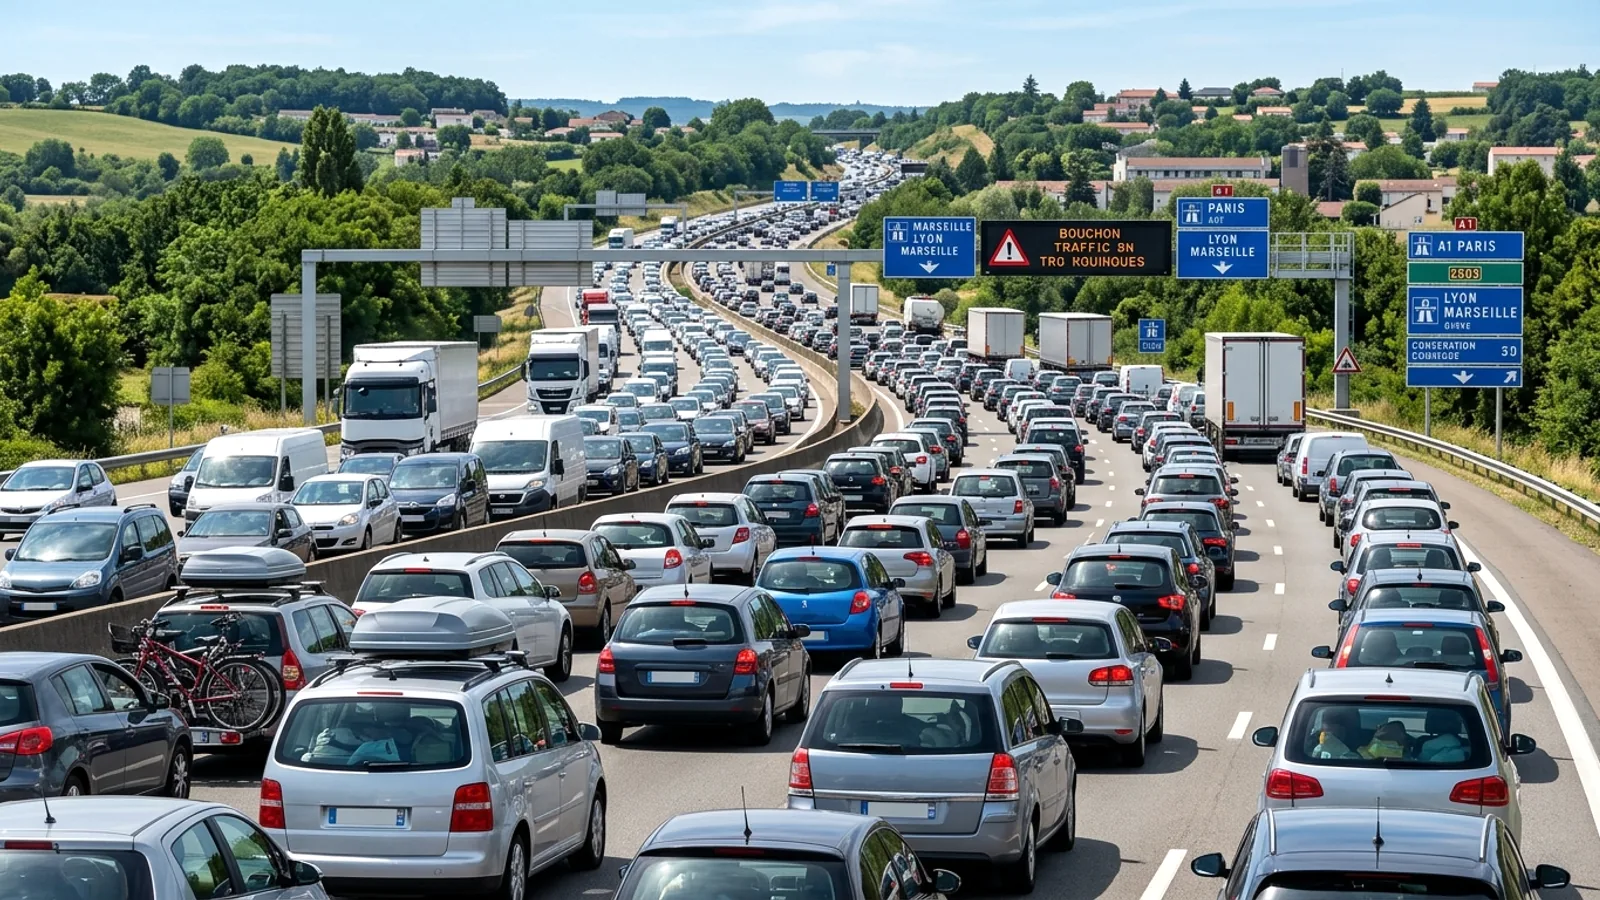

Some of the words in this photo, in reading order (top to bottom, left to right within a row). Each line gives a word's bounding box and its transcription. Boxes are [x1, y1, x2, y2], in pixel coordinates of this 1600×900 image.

[912, 222, 972, 231] MARSEILLE
[1059, 228, 1121, 239] BOUCHON
[1208, 234, 1237, 244] LYON
[901, 246, 958, 256] MARSEILLE
[1054, 242, 1110, 253] TRAFFIC
[1437, 240, 1452, 252] A1
[1457, 240, 1496, 252] PARIS
[1190, 247, 1255, 257] MARSEILLE
[1444, 292, 1477, 304] LYON
[1444, 307, 1518, 318] MARSEILLE
